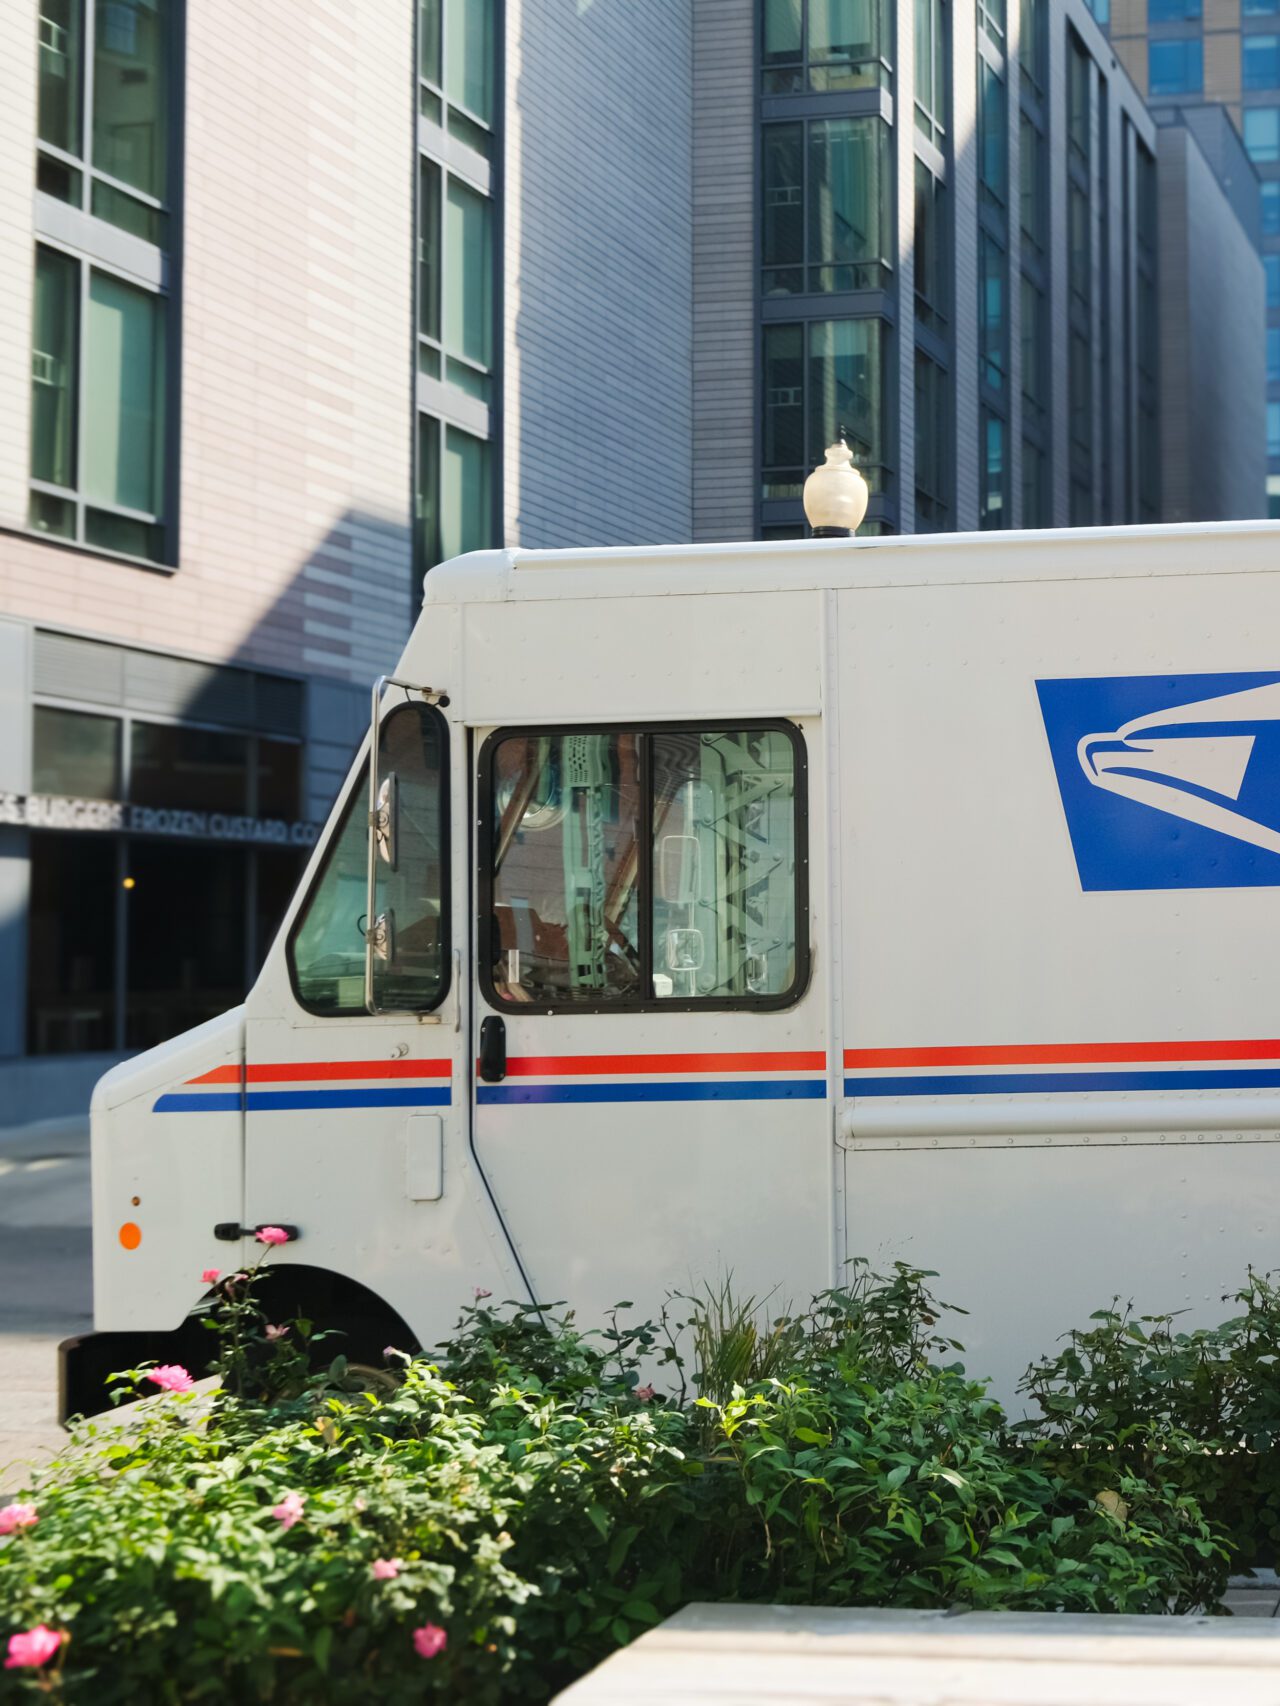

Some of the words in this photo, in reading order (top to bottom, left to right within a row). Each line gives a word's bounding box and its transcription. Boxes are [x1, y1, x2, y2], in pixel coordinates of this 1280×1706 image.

[131, 806, 205, 836] FROZEN
[209, 813, 288, 844] CUSTARD
[291, 820, 322, 847] CO
